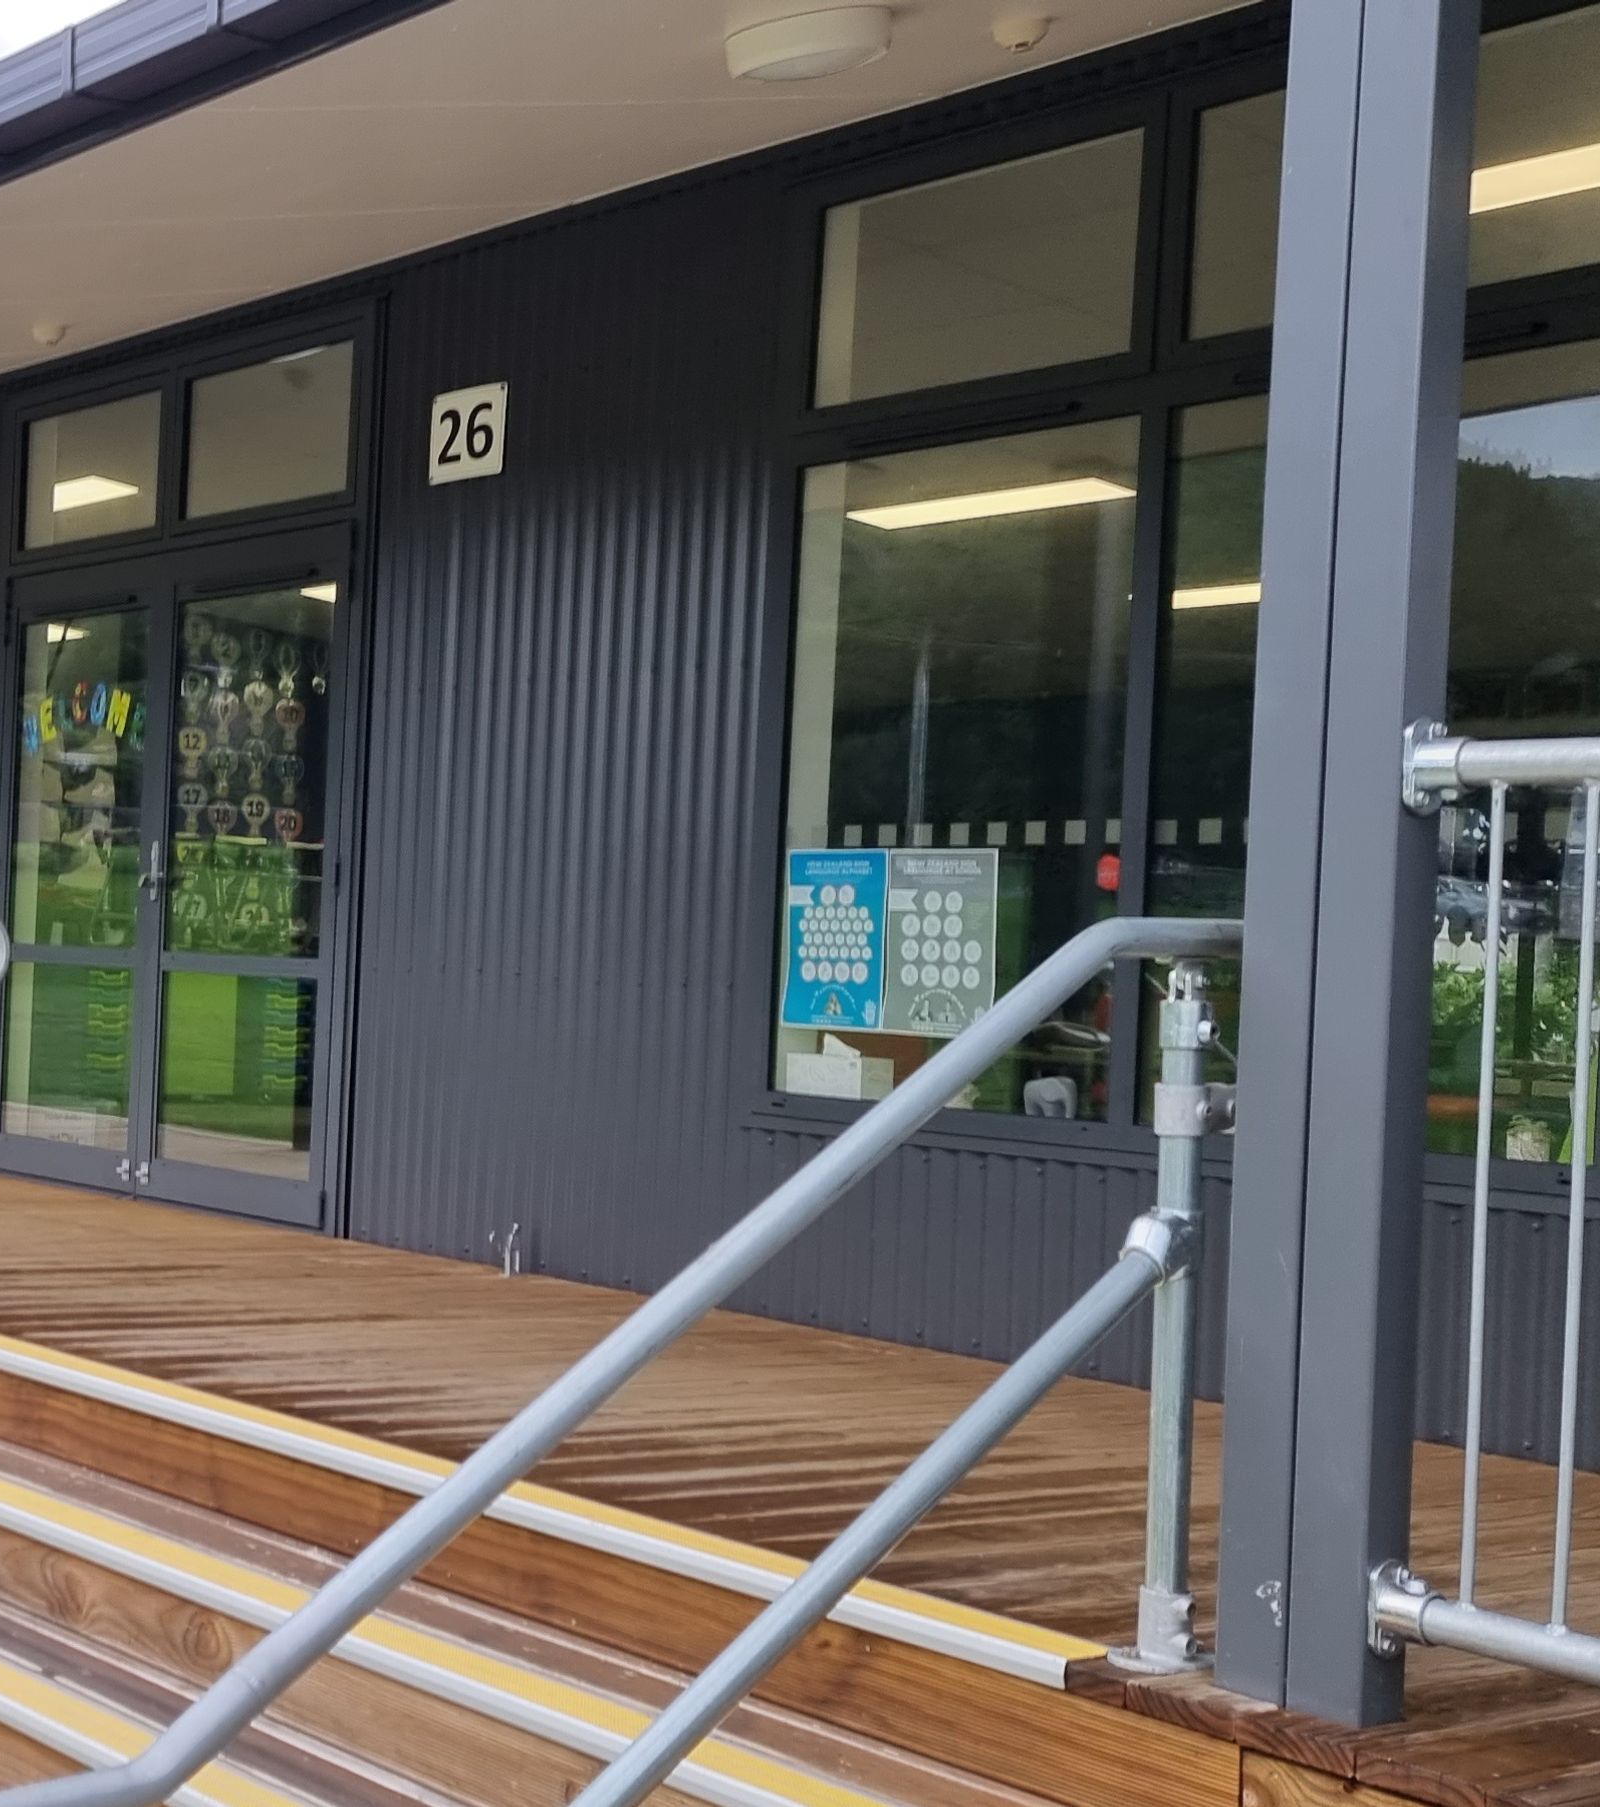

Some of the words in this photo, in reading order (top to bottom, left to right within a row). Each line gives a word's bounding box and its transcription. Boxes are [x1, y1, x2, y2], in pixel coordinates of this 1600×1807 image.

[438, 402, 493, 465] 26
[24, 681, 144, 752] WELCOME
[184, 734, 201, 750] 12
[184, 789, 202, 805] 17
[247, 801, 264, 817] 19
[278, 816, 297, 831] 20
